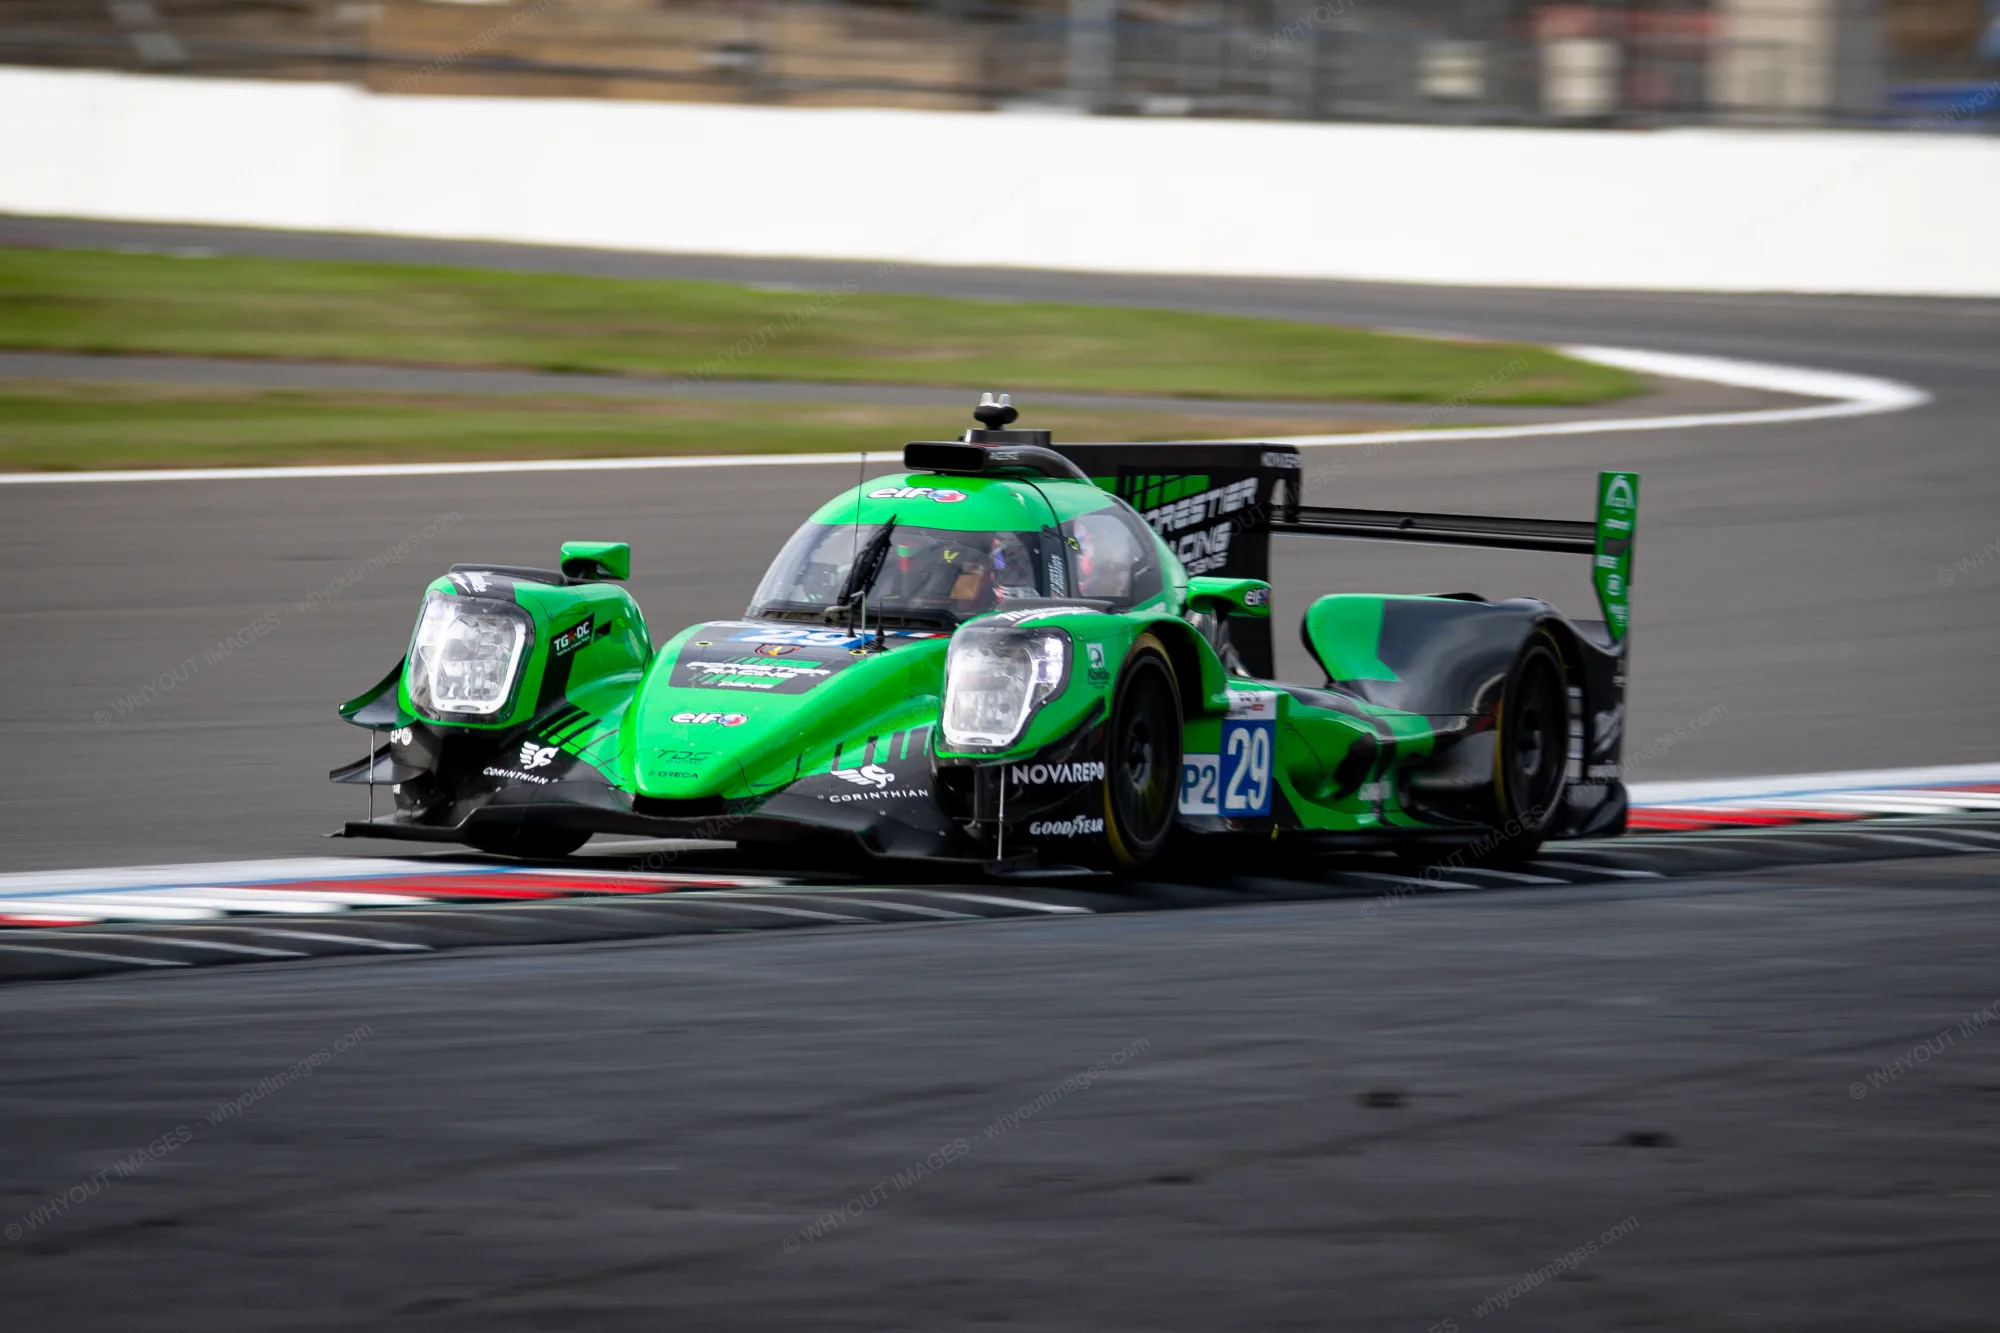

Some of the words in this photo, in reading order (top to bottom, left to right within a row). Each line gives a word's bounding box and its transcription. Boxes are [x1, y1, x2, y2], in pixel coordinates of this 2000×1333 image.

[1142, 478, 1258, 535] ORESTIER
[1171, 522, 1232, 564] CING
[741, 629, 859, 646] 29
[482, 767, 549, 785] CORINTHIAN
[1012, 761, 1105, 785] NOVAREPO
[1225, 727, 1270, 810] 29
[829, 789, 929, 803] CORINTHIAN
[1182, 764, 1217, 805] P2
[1029, 815, 1104, 839] GOODYEAR
